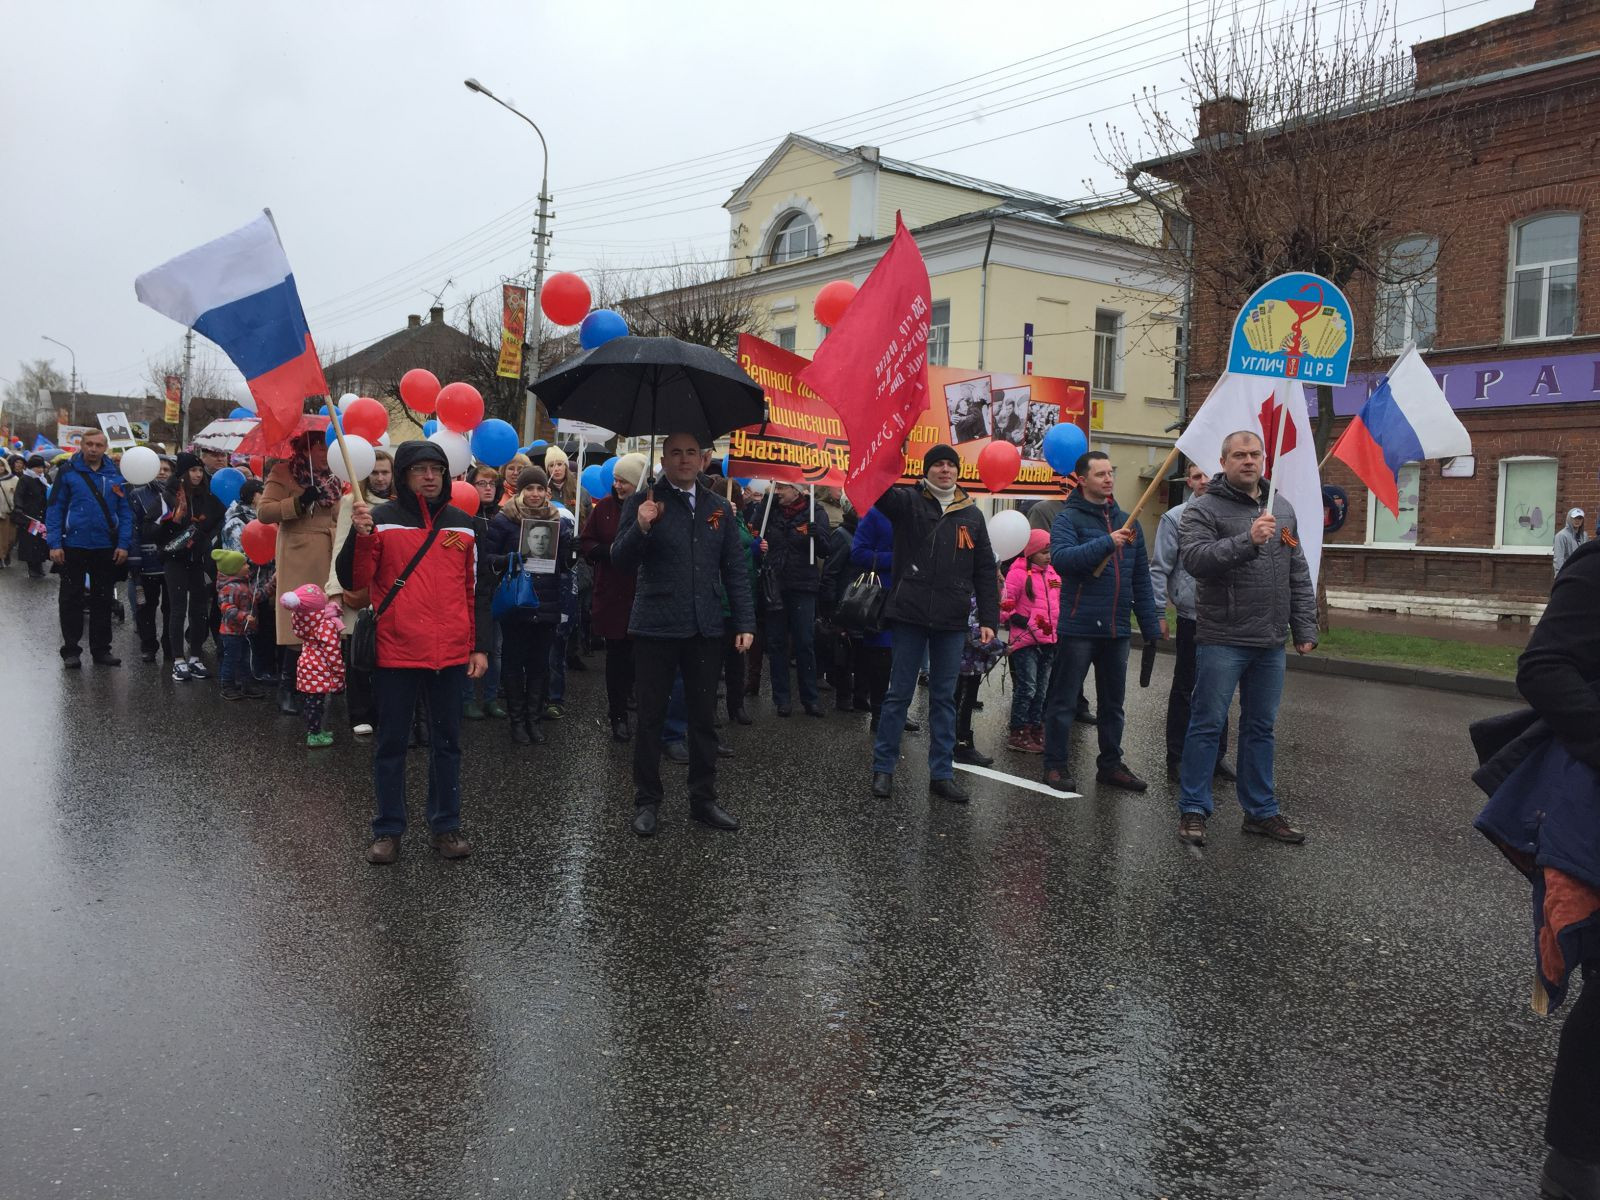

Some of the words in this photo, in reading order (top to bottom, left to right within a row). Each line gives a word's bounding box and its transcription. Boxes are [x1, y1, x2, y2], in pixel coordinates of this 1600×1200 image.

[1241, 355, 1285, 373] УГЛИЧ
[1304, 361, 1334, 377] ЦРБ
[734, 430, 833, 469] Участникам
